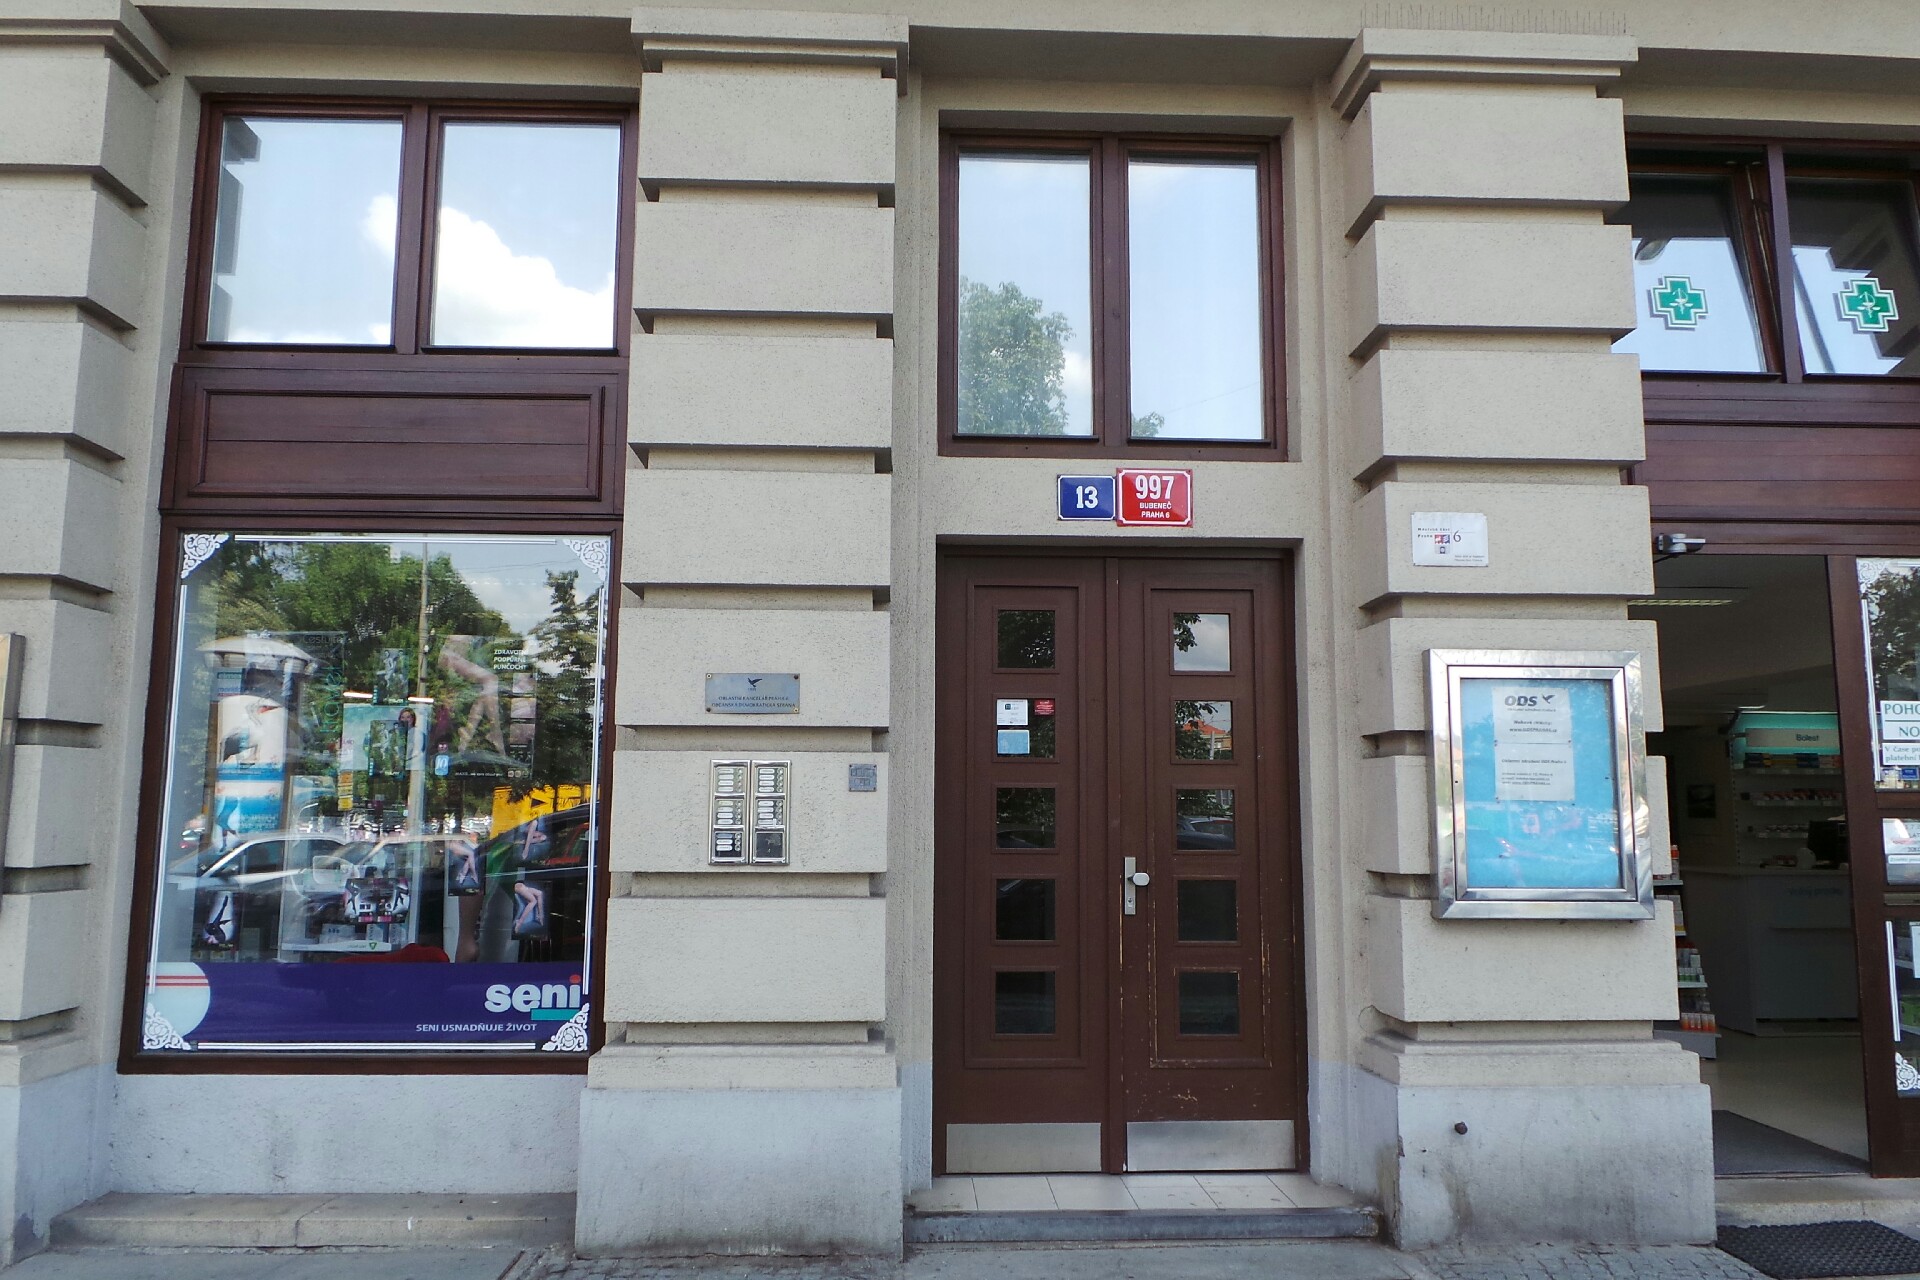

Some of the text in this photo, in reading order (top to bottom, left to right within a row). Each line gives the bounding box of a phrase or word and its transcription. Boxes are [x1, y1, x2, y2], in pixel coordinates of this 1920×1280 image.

[1135, 475, 1175, 500] 997
[1075, 485, 1099, 509] 13
[1139, 501, 1172, 510] BUBENEČ
[1141, 510, 1170, 519] PRAHA 6
[1453, 529, 1462, 543] 6
[1504, 695, 1538, 707] ODS
[484, 974, 582, 1013] seni
[415, 1022, 538, 1032] SENI USNADŇUJE ŽIVOT
